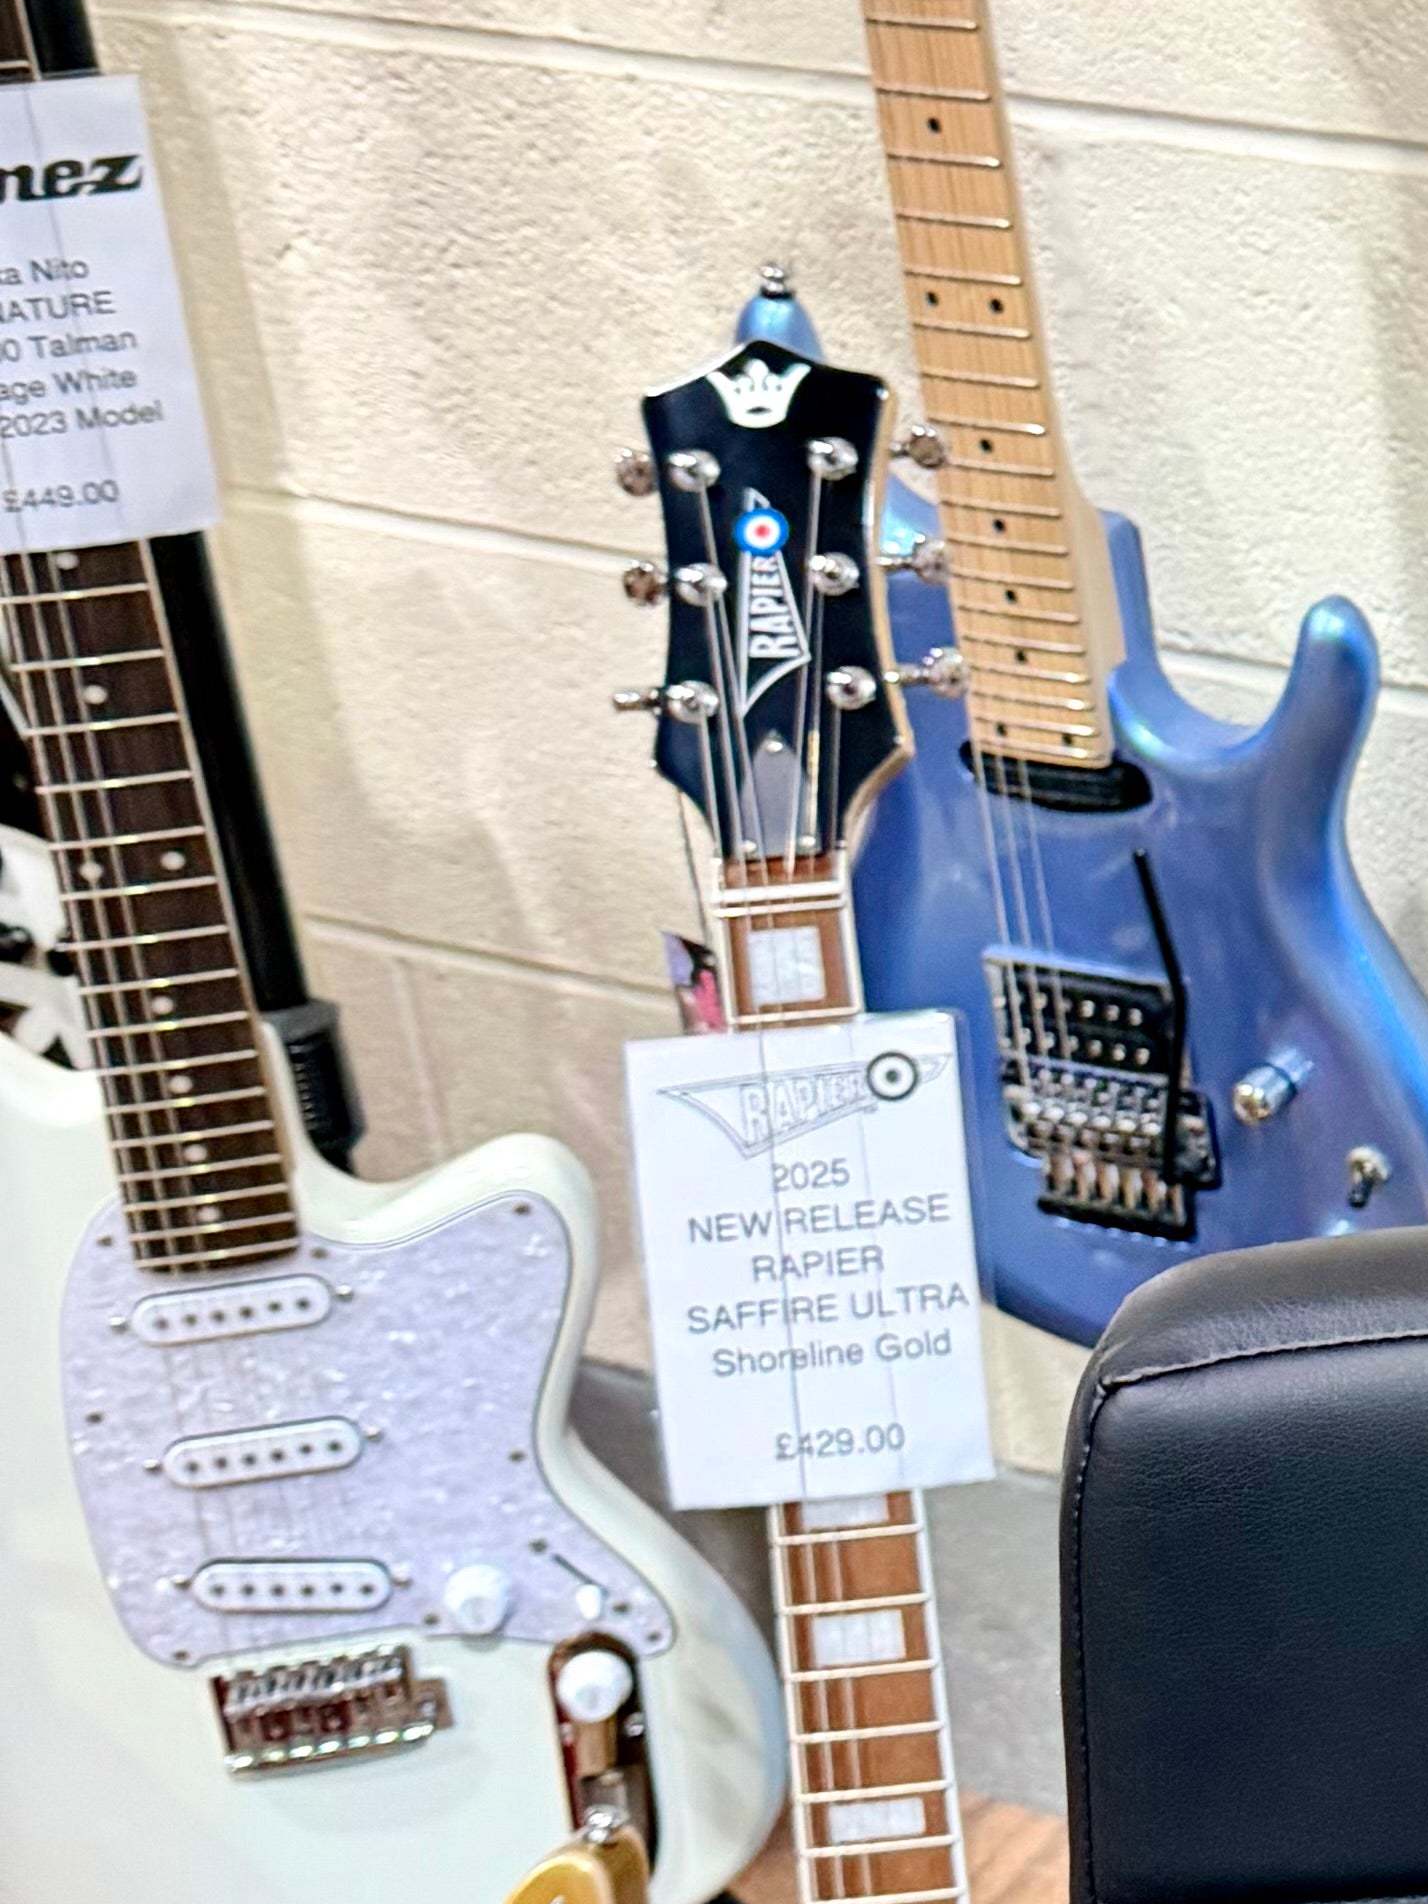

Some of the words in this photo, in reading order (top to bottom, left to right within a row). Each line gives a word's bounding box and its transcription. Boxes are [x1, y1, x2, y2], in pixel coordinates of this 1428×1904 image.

[31, 259, 89, 282] Nito
[27, 332, 138, 359] Talman
[52, 370, 137, 394] White
[0, 410, 67, 438] 2023
[75, 399, 164, 430] Model
[2, 479, 119, 512] £449.00
[749, 556, 800, 658] RAPIER
[740, 1072, 866, 1145] RAPIER
[773, 1158, 850, 1192] 2025
[688, 1211, 772, 1243] NEW
[784, 1193, 950, 1235] RELEASE
[752, 1245, 885, 1283] RAPIER
[687, 1294, 839, 1334] SAFFIRE
[851, 1282, 970, 1319] ULTRA
[713, 1340, 864, 1377] Shoreline
[875, 1329, 951, 1362] Gold
[775, 1422, 905, 1461] £429.00
